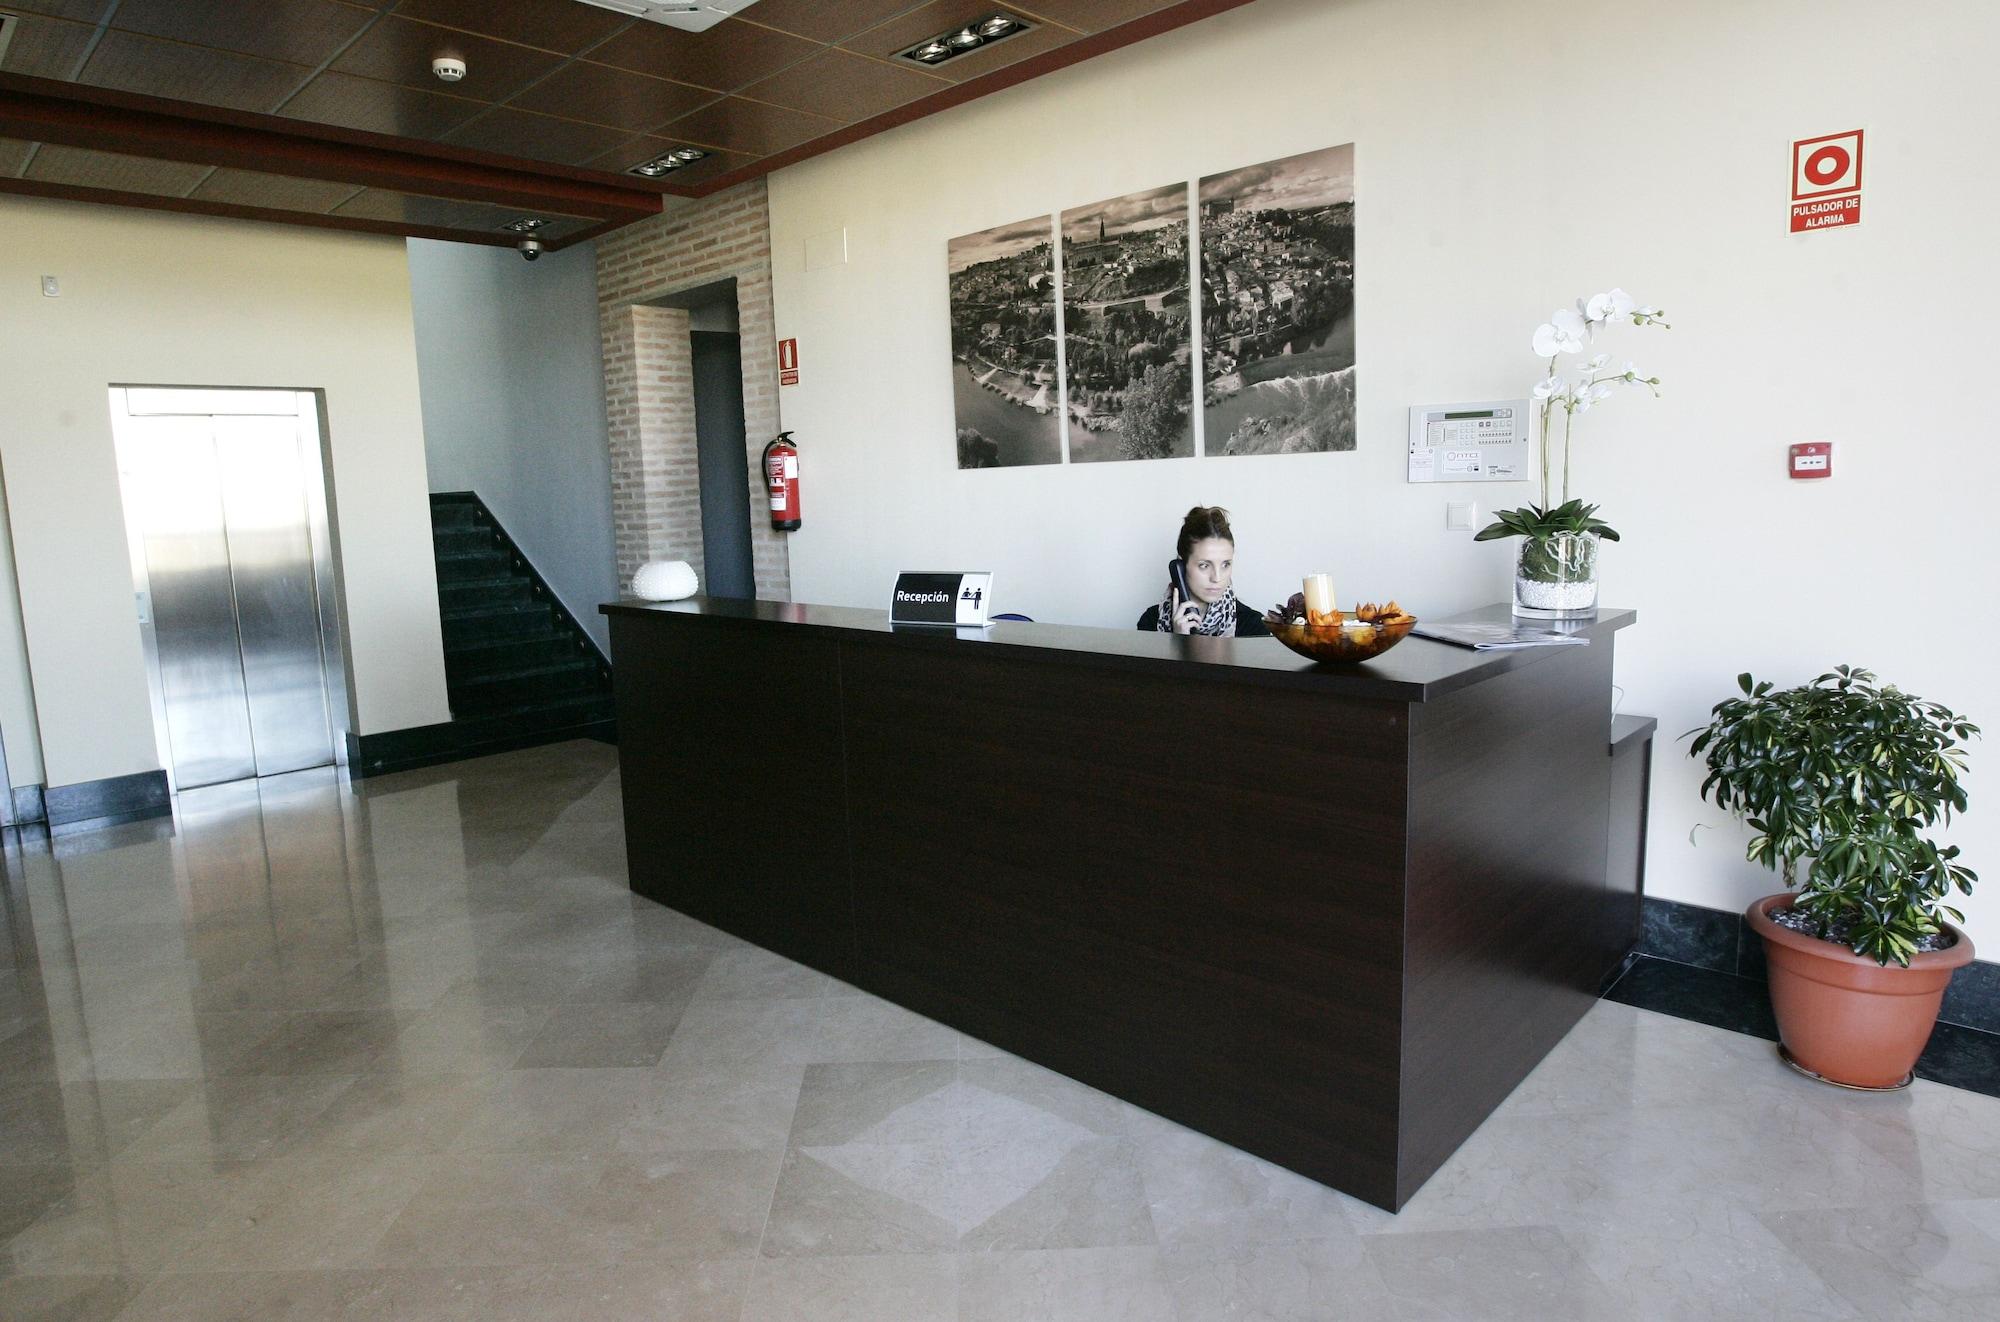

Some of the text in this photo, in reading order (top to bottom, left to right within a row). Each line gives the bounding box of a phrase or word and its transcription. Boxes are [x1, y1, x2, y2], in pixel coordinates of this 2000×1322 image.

[1793, 198, 1859, 216] PULSADOR DE
[1806, 214, 1844, 228] ALARMA
[896, 590, 949, 604] Recepción
